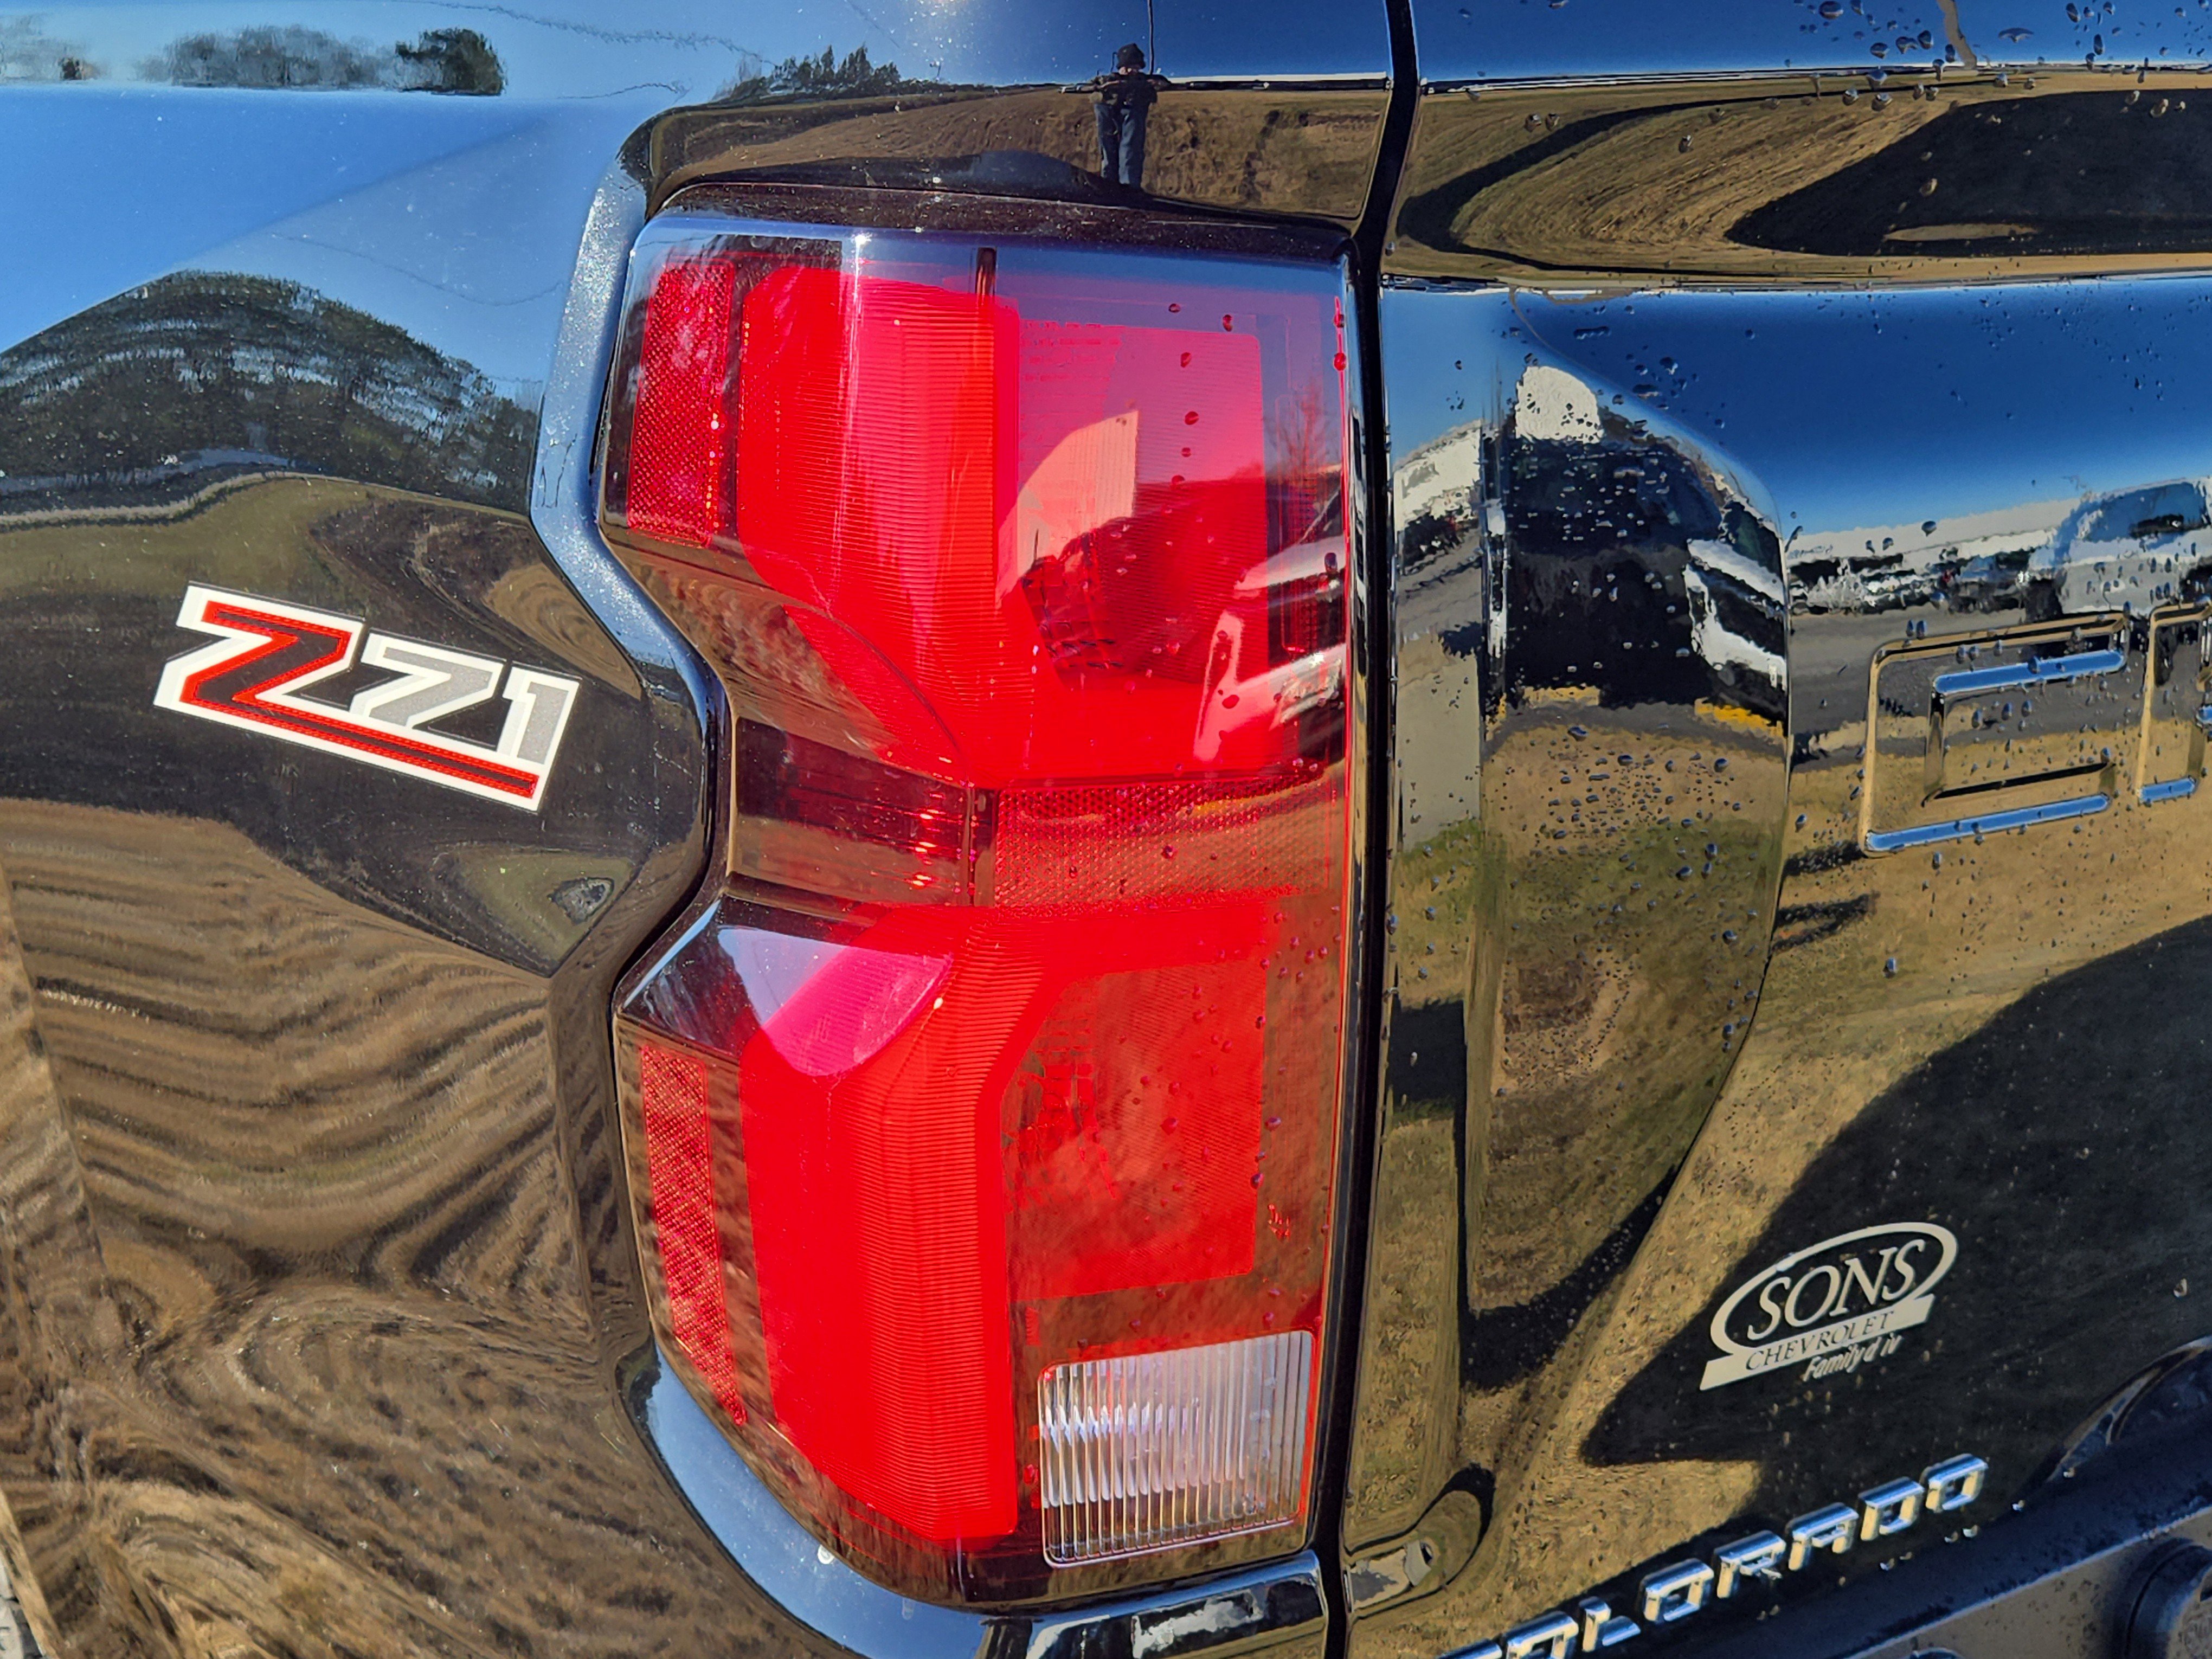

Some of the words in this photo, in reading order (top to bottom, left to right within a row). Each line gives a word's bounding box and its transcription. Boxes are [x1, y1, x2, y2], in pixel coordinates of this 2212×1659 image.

[153, 585, 581, 811] Z71
[1747, 1239, 1925, 1340] SONS
[1745, 1310, 1895, 1371] CHEVROLET
